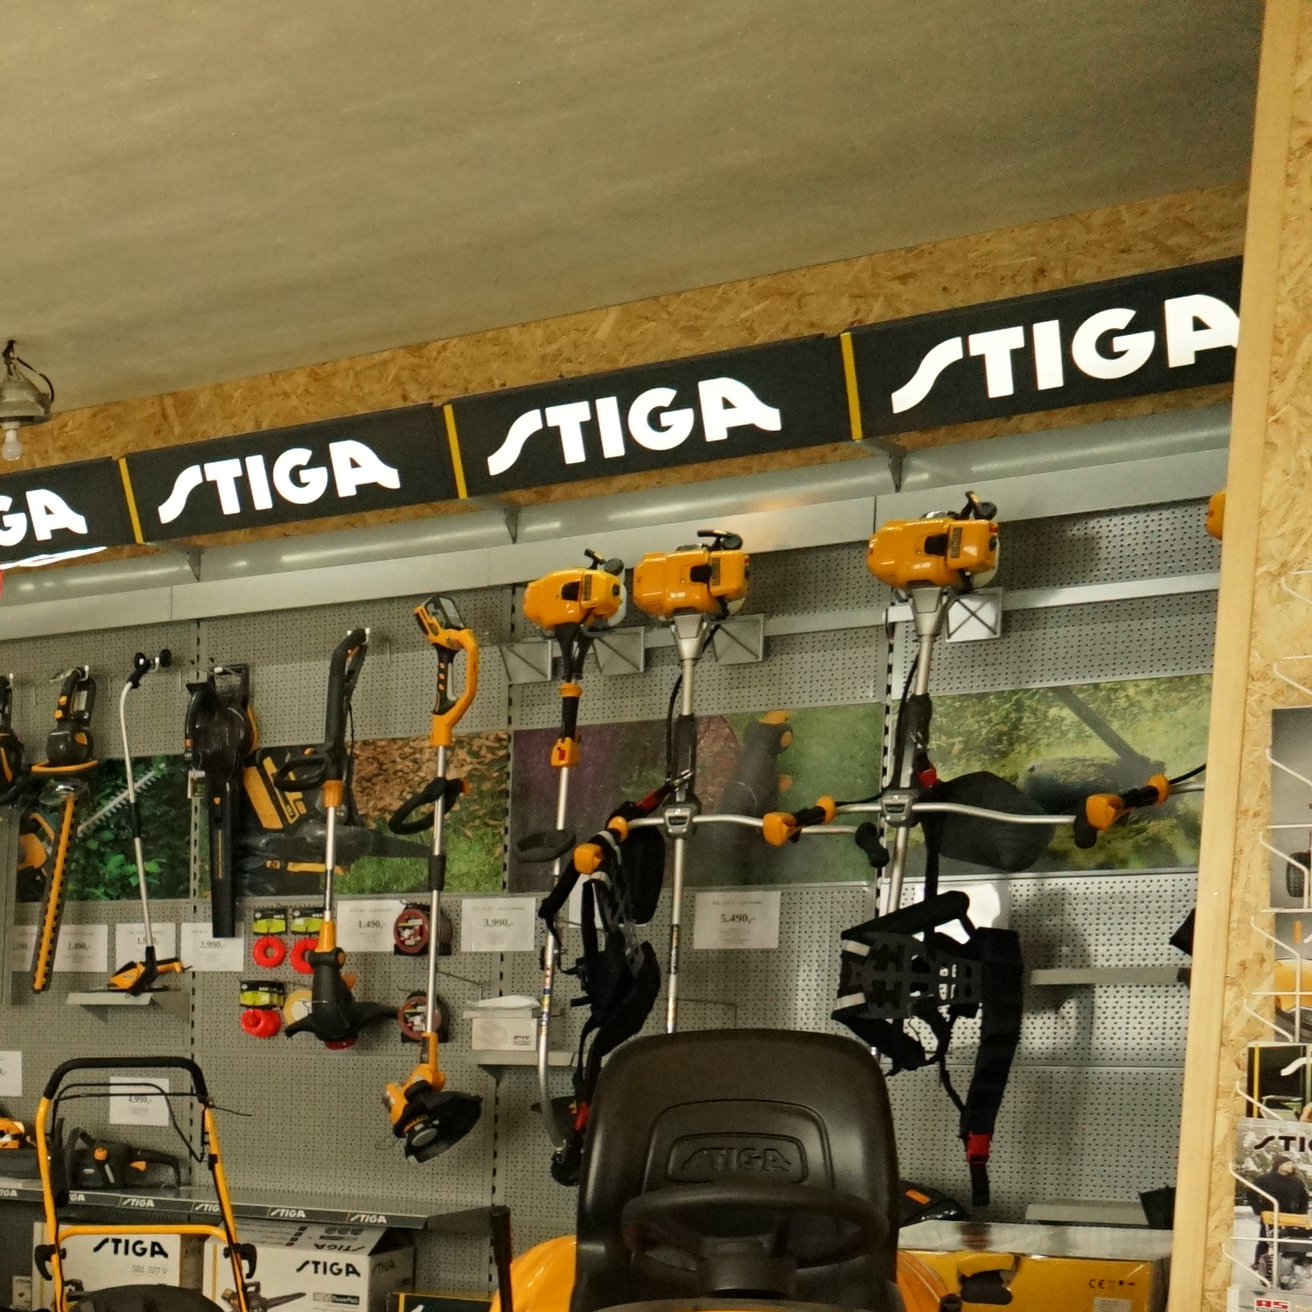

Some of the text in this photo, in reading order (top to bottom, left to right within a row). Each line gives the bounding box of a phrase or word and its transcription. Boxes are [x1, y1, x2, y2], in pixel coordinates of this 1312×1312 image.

[892, 293, 1240, 414] STIGA
[487, 376, 782, 476] STIGA
[158, 438, 401, 525] STIGA
[122, 1197, 155, 1208] STIGA
[270, 1208, 306, 1219] STIGA
[350, 1213, 388, 1224] STIGA
[93, 1237, 169, 1258] STIGA
[296, 1260, 361, 1278] STIGA
